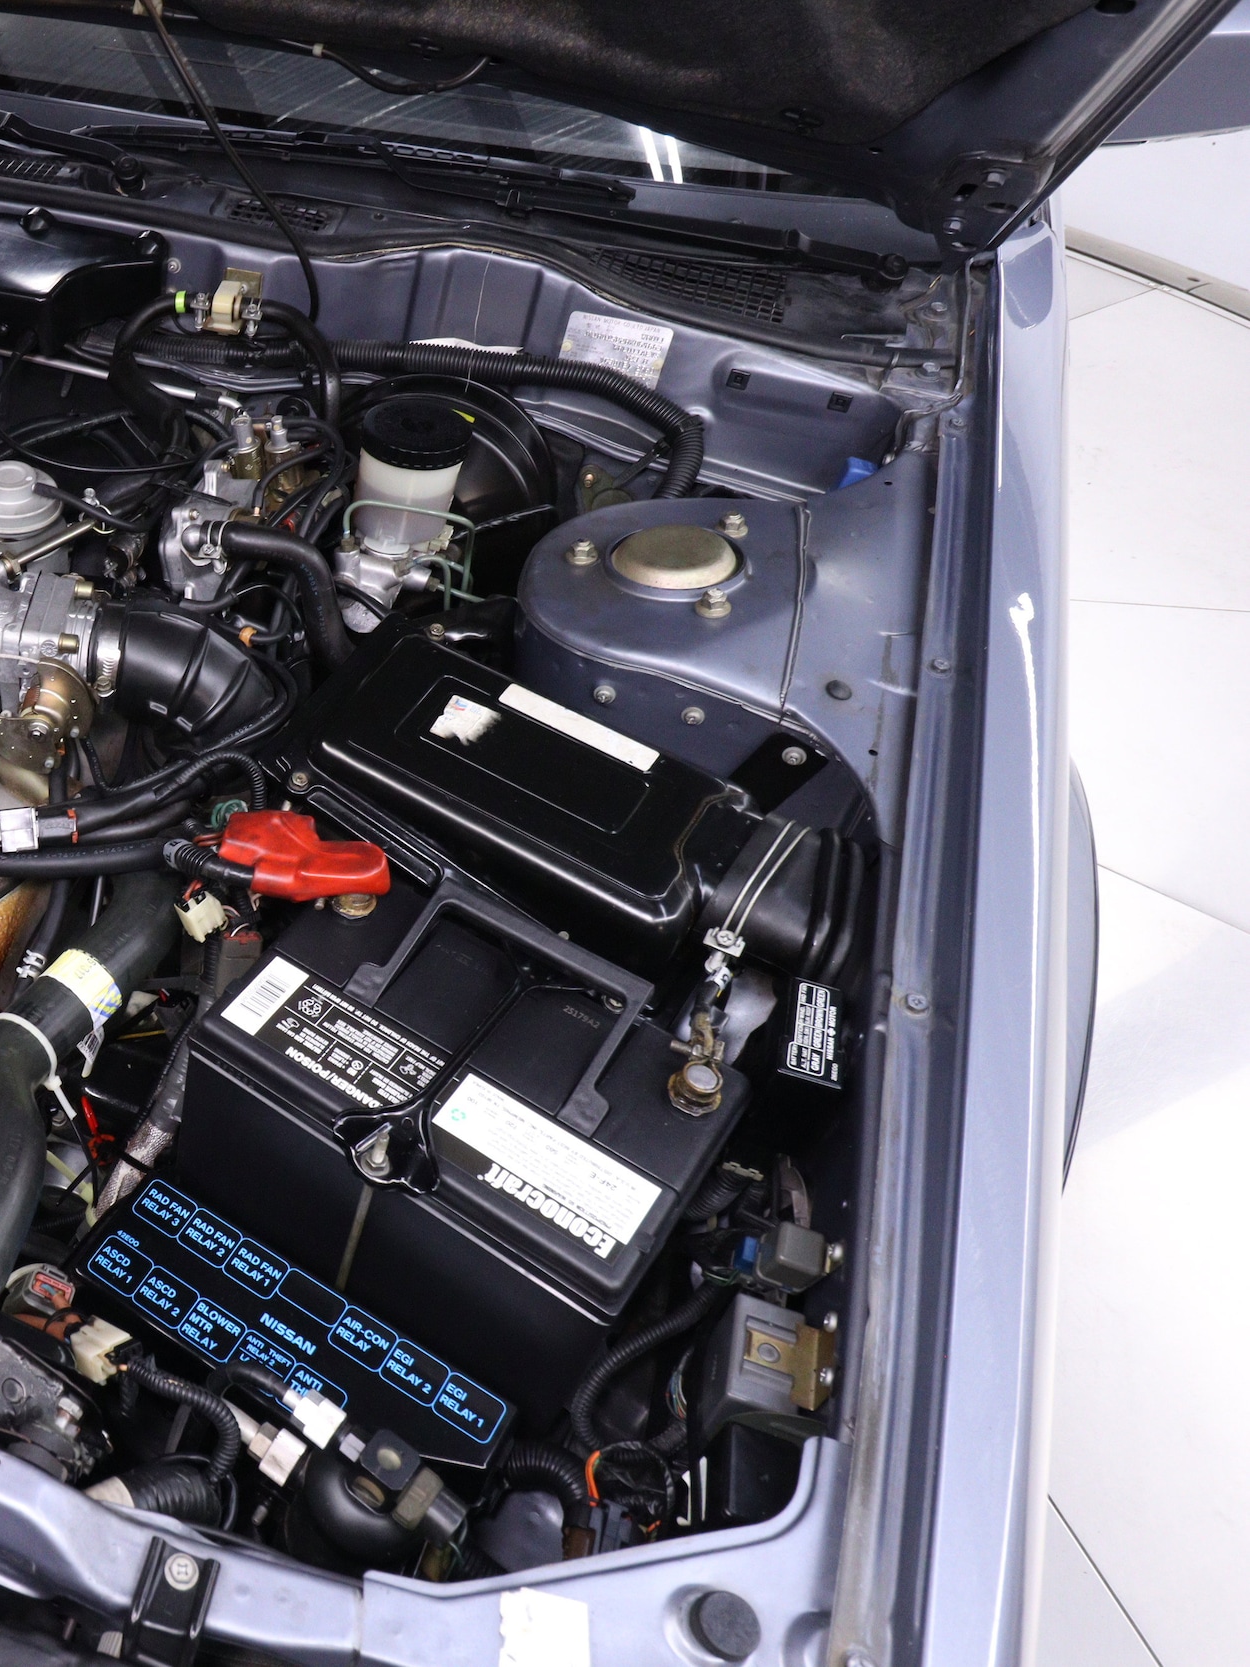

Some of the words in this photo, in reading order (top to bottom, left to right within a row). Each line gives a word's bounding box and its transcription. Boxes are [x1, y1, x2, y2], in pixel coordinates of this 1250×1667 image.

[829, 1006, 837, 1028] MOTOR
[811, 1052, 820, 1071] GRAY
[827, 1038, 835, 1060] NISSAN
[285, 1047, 381, 1108] DANGER/POISON
[142, 1198, 173, 1220] RELAY
[172, 1218, 180, 1226] 3
[149, 1189, 170, 1205] RAD
[169, 1202, 190, 1219] FAN
[481, 1163, 619, 1258] Econocraft
[185, 1227, 217, 1250] RELAY
[216, 1248, 225, 1257] 2
[193, 1218, 214, 1235] RAD
[214, 1231, 235, 1249] FAN
[95, 1254, 126, 1278] RELAY
[103, 1246, 130, 1266] ASCD
[231, 1257, 264, 1281] RELAY
[238, 1248, 260, 1265] RAD
[260, 1262, 282, 1280] FAN
[148, 1277, 176, 1298] ASCD
[140, 1286, 172, 1309] RELAY
[171, 1307, 180, 1317] 2
[189, 1313, 213, 1332] MTR
[196, 1302, 241, 1336] BLOWER
[179, 1323, 217, 1350] RELAY
[260, 1313, 316, 1355] NISSAN
[336, 1326, 371, 1352] RELAY
[342, 1317, 389, 1350] AIR-CON
[246, 1335, 264, 1349] ANTI
[269, 1348, 292, 1367] THEFT
[246, 1344, 270, 1361] RELAY
[393, 1348, 414, 1366] EGI
[295, 1370, 323, 1392] ANTI
[386, 1359, 423, 1386] RELAY
[422, 1383, 431, 1394] 2
[445, 1382, 467, 1401] EGI
[439, 1394, 477, 1421] RELAY
[478, 1418, 484, 1427] 1
